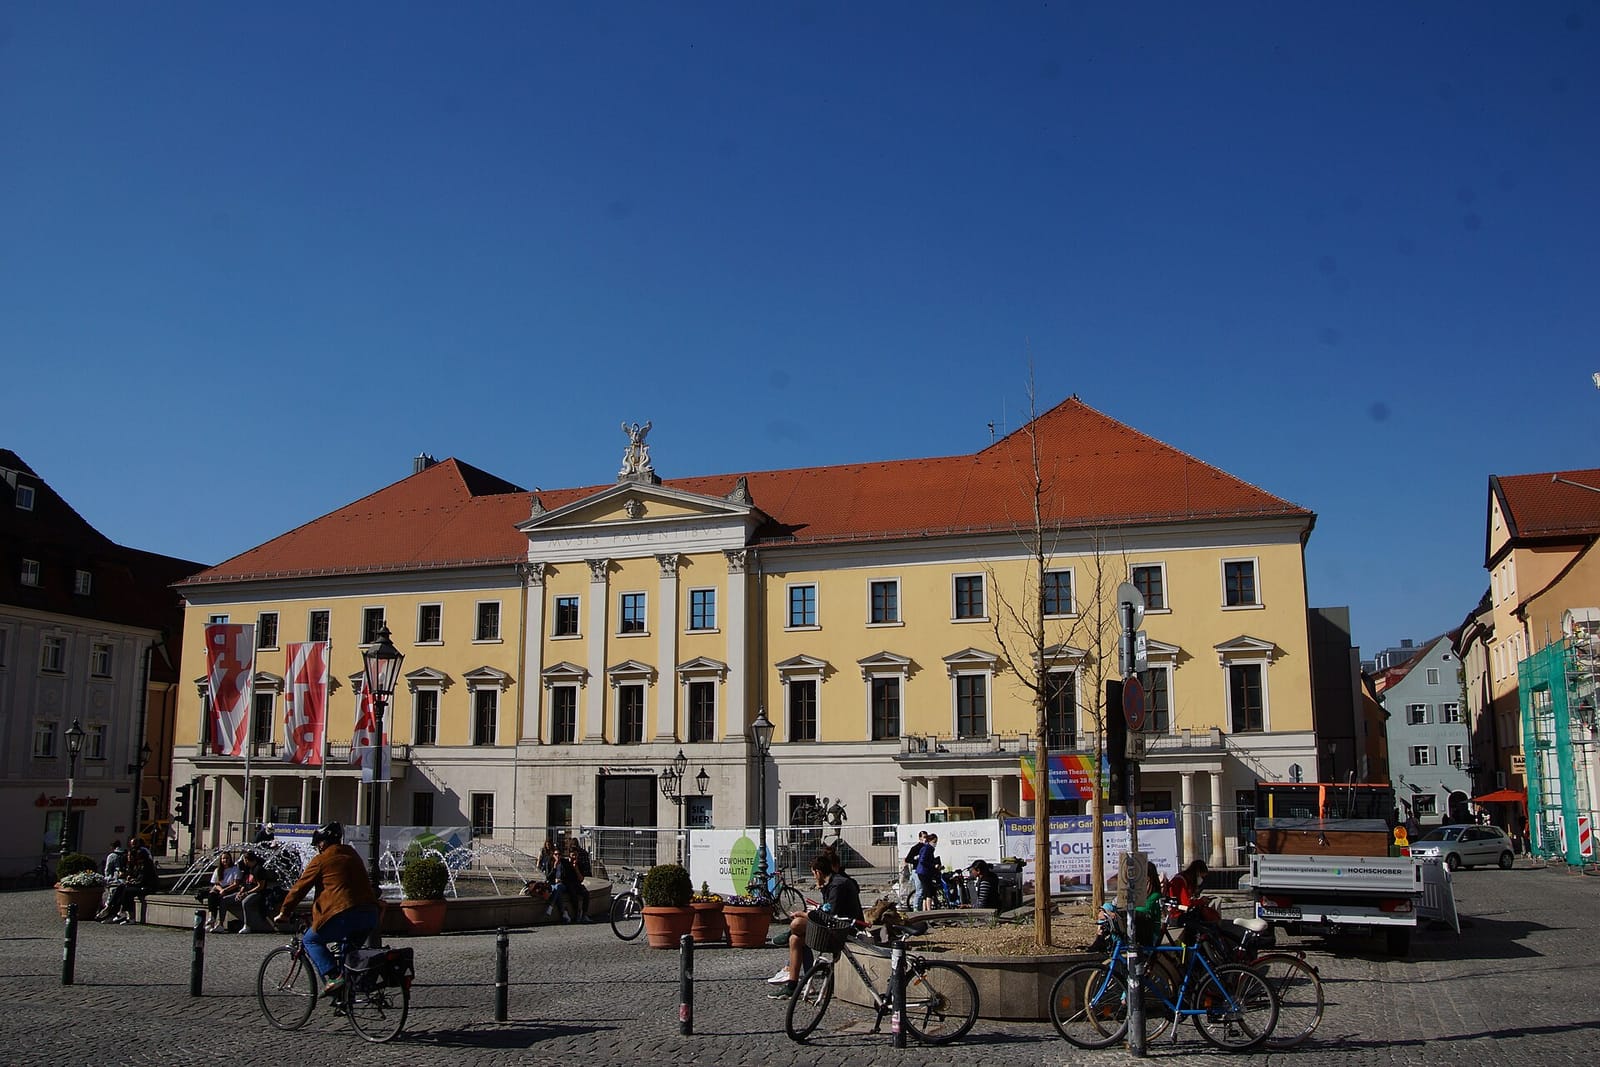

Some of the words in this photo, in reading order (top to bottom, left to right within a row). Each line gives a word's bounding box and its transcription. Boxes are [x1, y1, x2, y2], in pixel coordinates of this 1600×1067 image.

[612, 525, 722, 545] FAVENTIBVS
[48, 795, 98, 807] Sanander
[719, 857, 754, 865] GEWOHNTE
